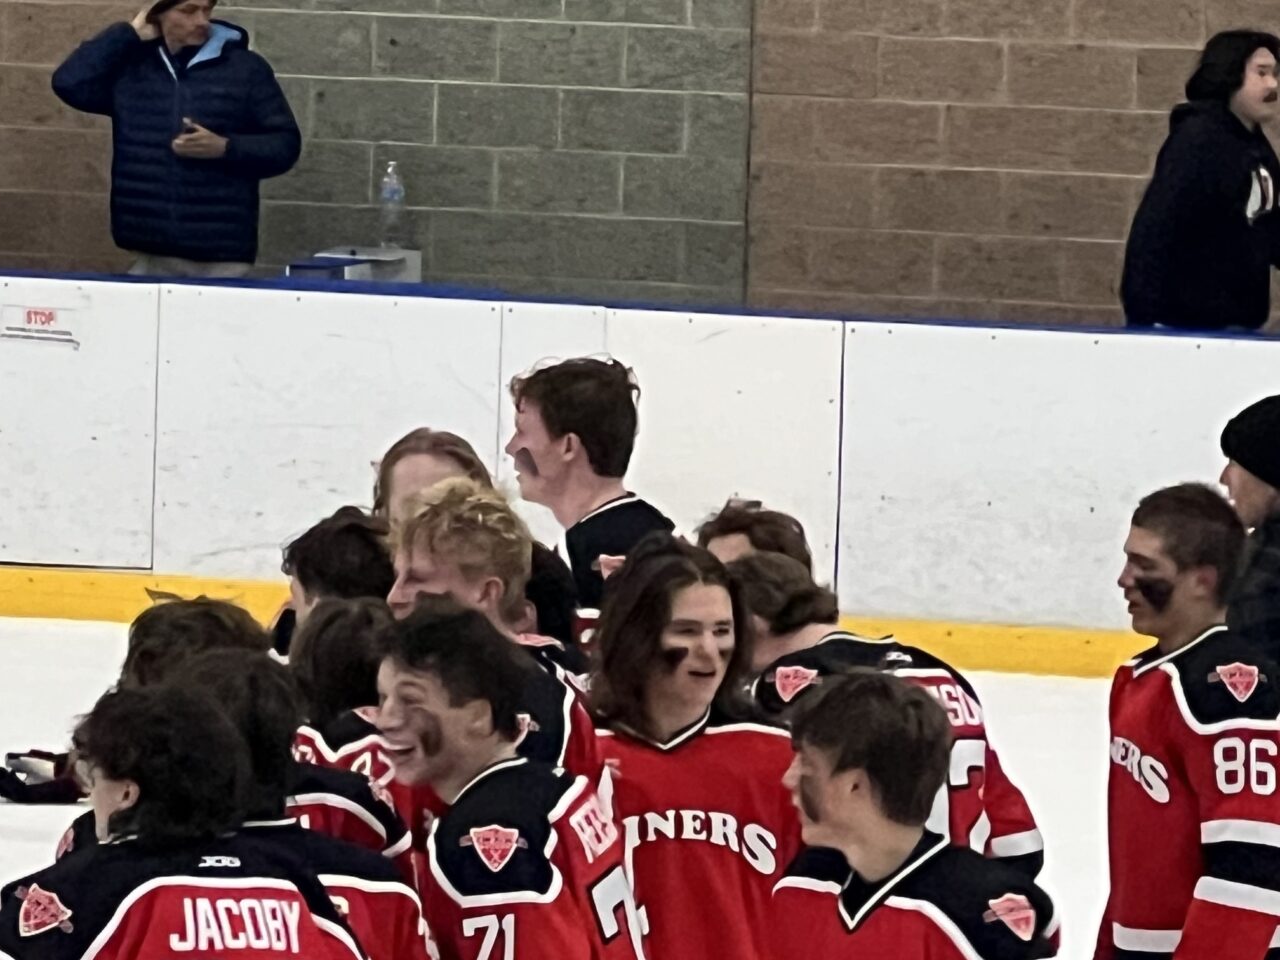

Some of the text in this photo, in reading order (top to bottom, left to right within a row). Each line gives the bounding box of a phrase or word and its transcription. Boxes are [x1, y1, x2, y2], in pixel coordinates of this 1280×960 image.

[25, 309, 55, 326] STOP
[1213, 736, 1278, 796] 86
[168, 897, 302, 954] JACOBY
